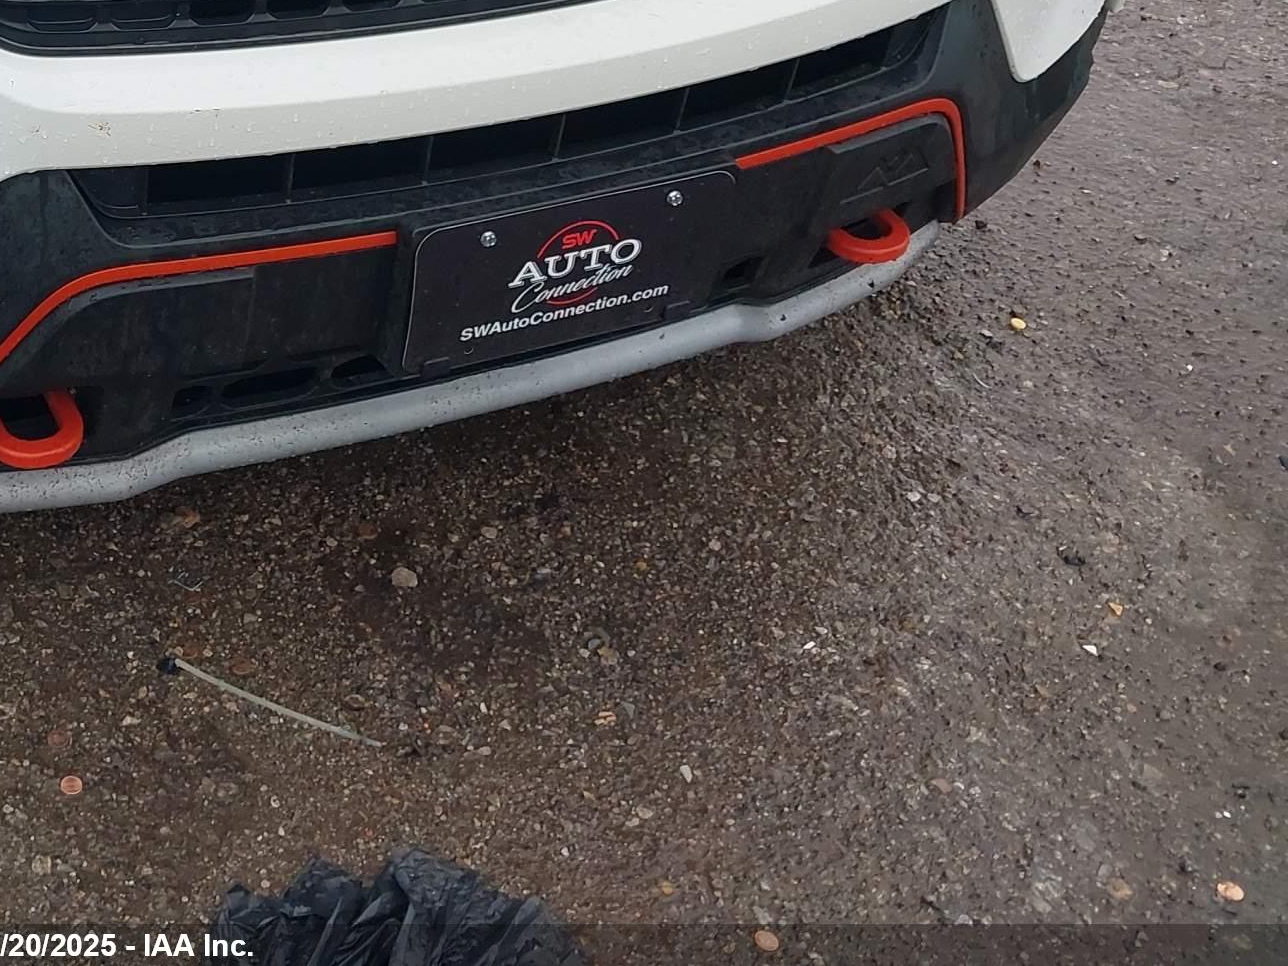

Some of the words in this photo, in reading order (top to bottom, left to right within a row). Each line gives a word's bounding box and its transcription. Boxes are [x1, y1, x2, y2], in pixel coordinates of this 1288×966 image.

[508, 239, 642, 288] AUTO
[562, 229, 597, 250] SW
[460, 285, 669, 341] SWAutoConnection.com
[511, 264, 634, 313] Connection
